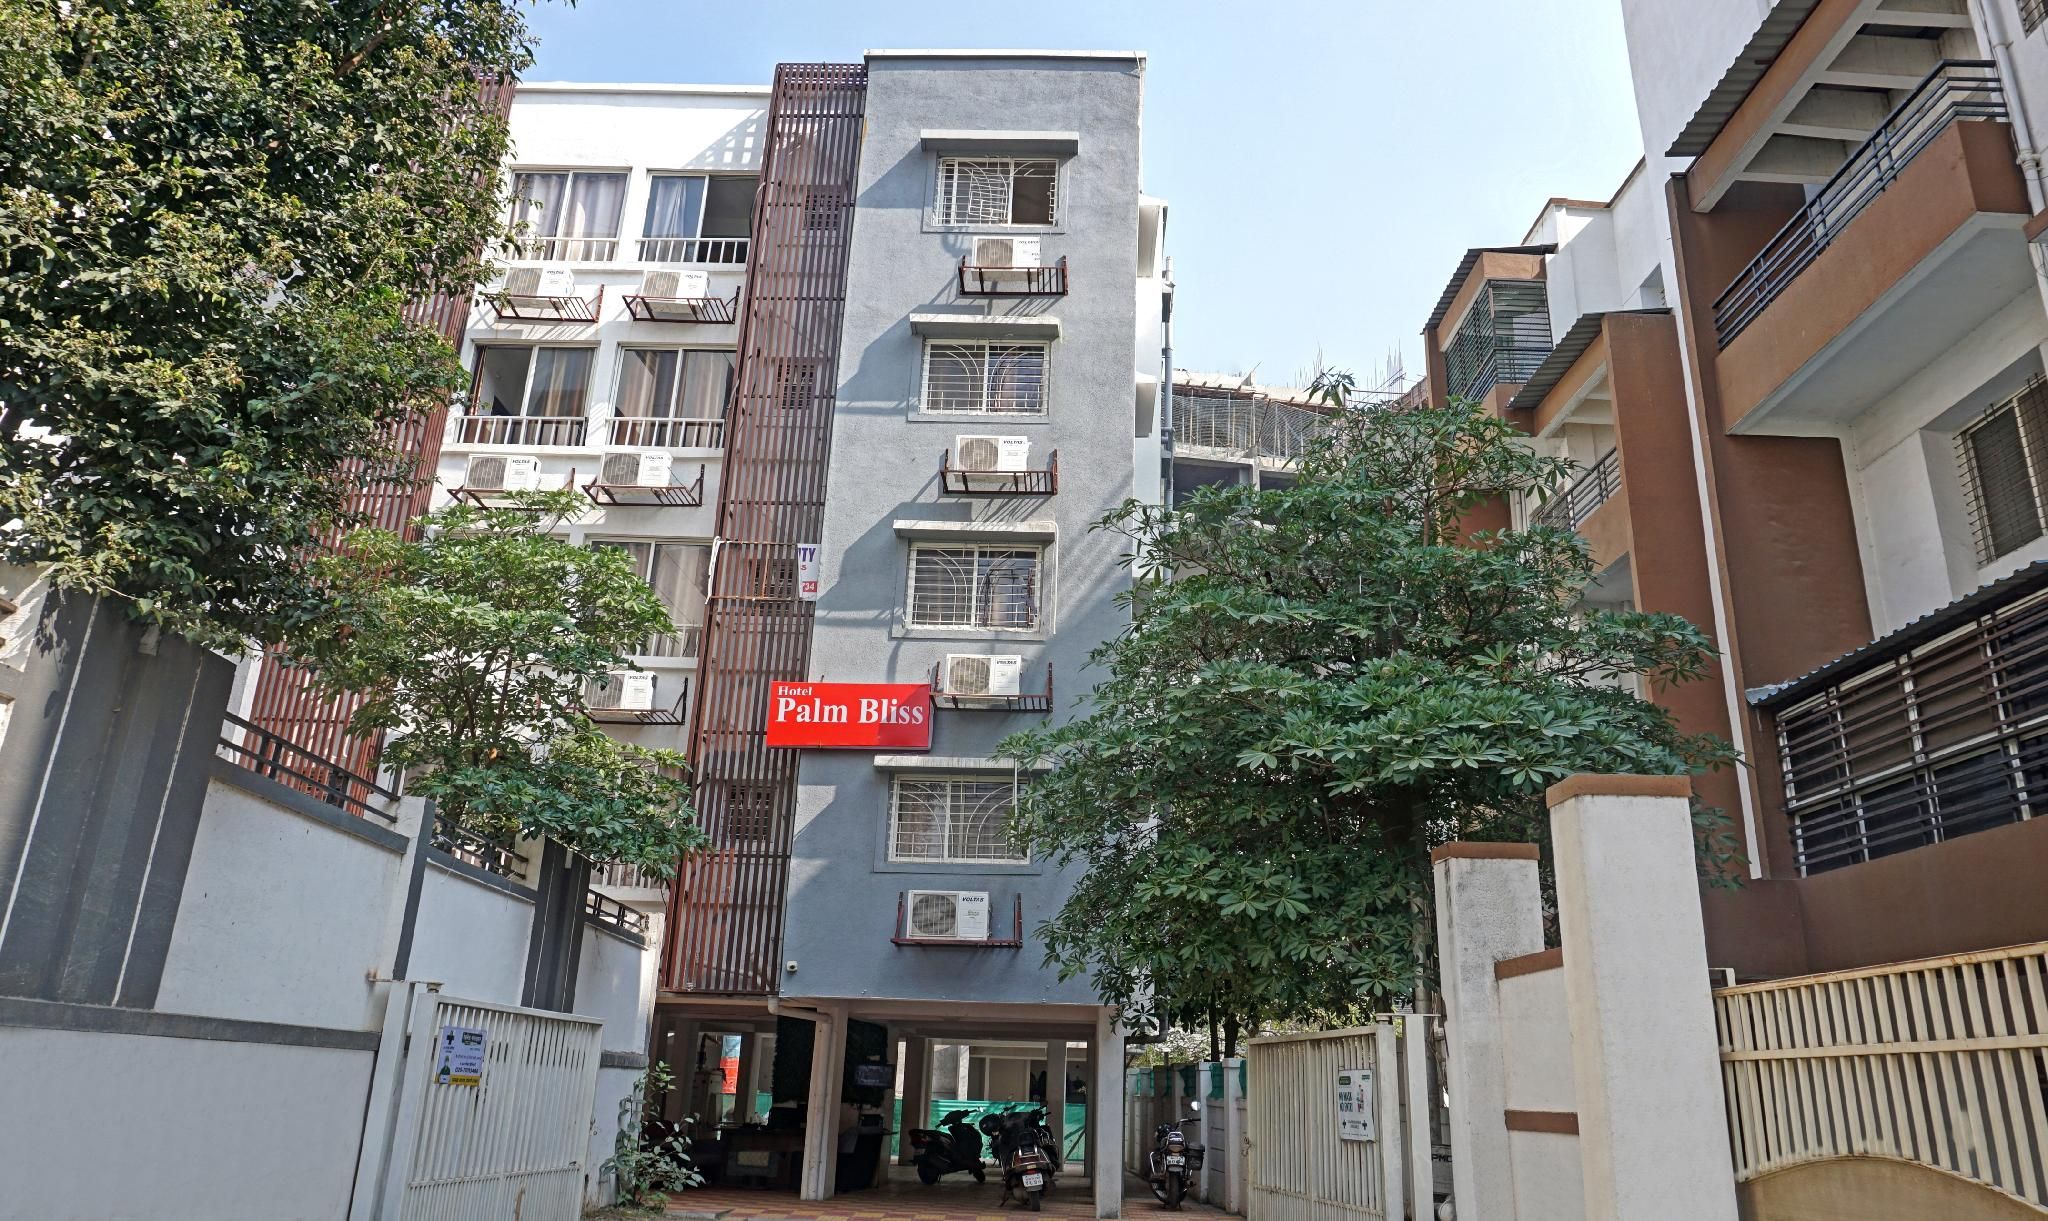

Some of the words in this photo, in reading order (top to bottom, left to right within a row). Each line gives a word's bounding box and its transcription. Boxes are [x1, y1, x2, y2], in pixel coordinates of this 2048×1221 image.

[778, 686, 812, 696] Hotel
[776, 697, 848, 724] Palm
[857, 698, 924, 725] Bliss
